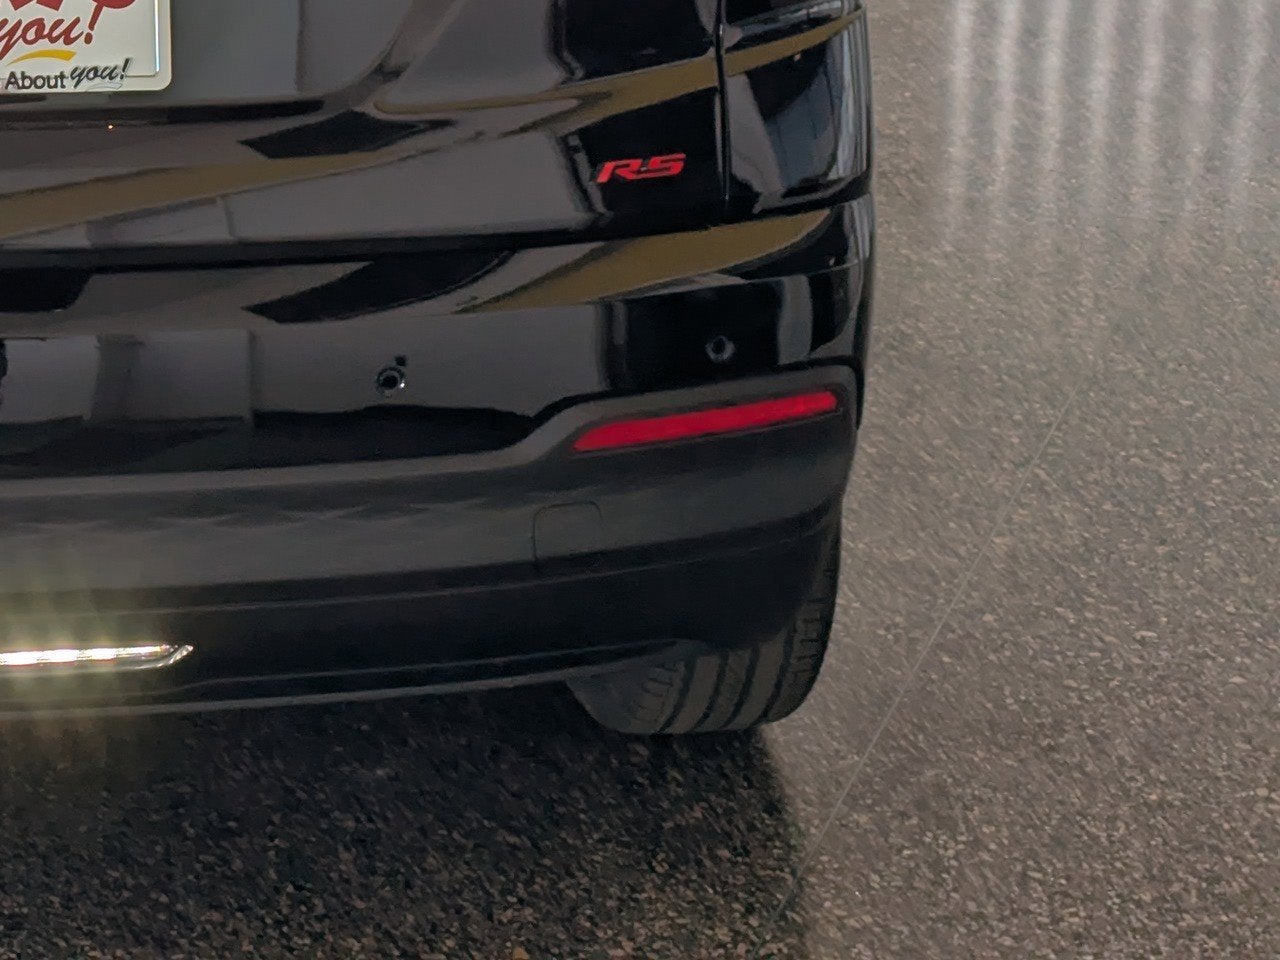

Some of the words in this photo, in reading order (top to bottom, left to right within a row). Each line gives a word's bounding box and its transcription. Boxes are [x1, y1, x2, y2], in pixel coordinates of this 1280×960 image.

[5, 70, 68, 89] About
[70, 57, 132, 89] you!
[596, 152, 686, 183] RS
